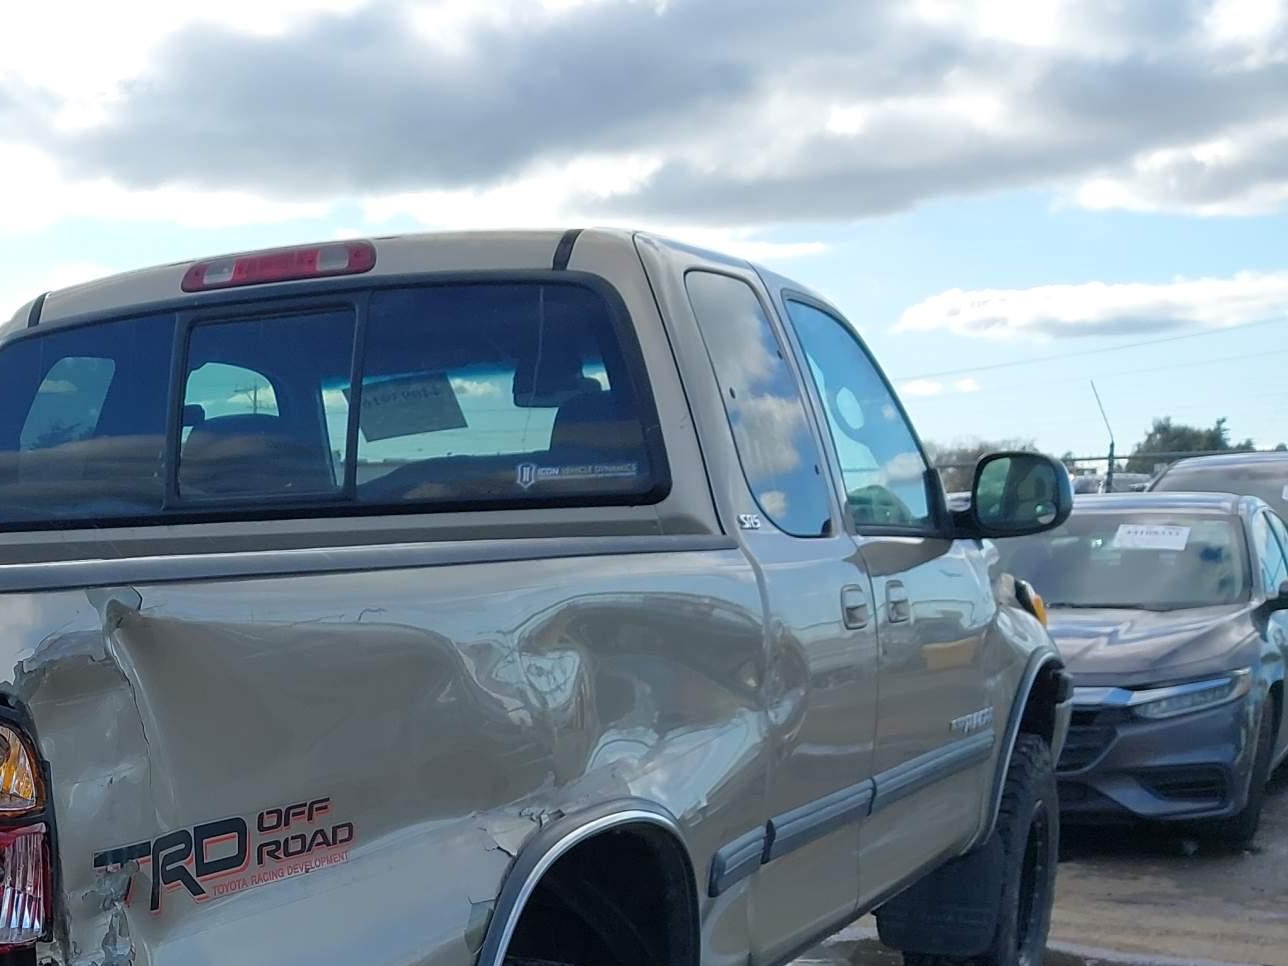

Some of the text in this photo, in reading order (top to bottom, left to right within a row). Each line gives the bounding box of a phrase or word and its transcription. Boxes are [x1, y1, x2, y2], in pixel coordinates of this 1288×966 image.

[93, 797, 331, 915] TRD OFF
[257, 821, 355, 868] ROAD
[213, 850, 350, 897] TOYOTA RACING DEVELOPMENT
